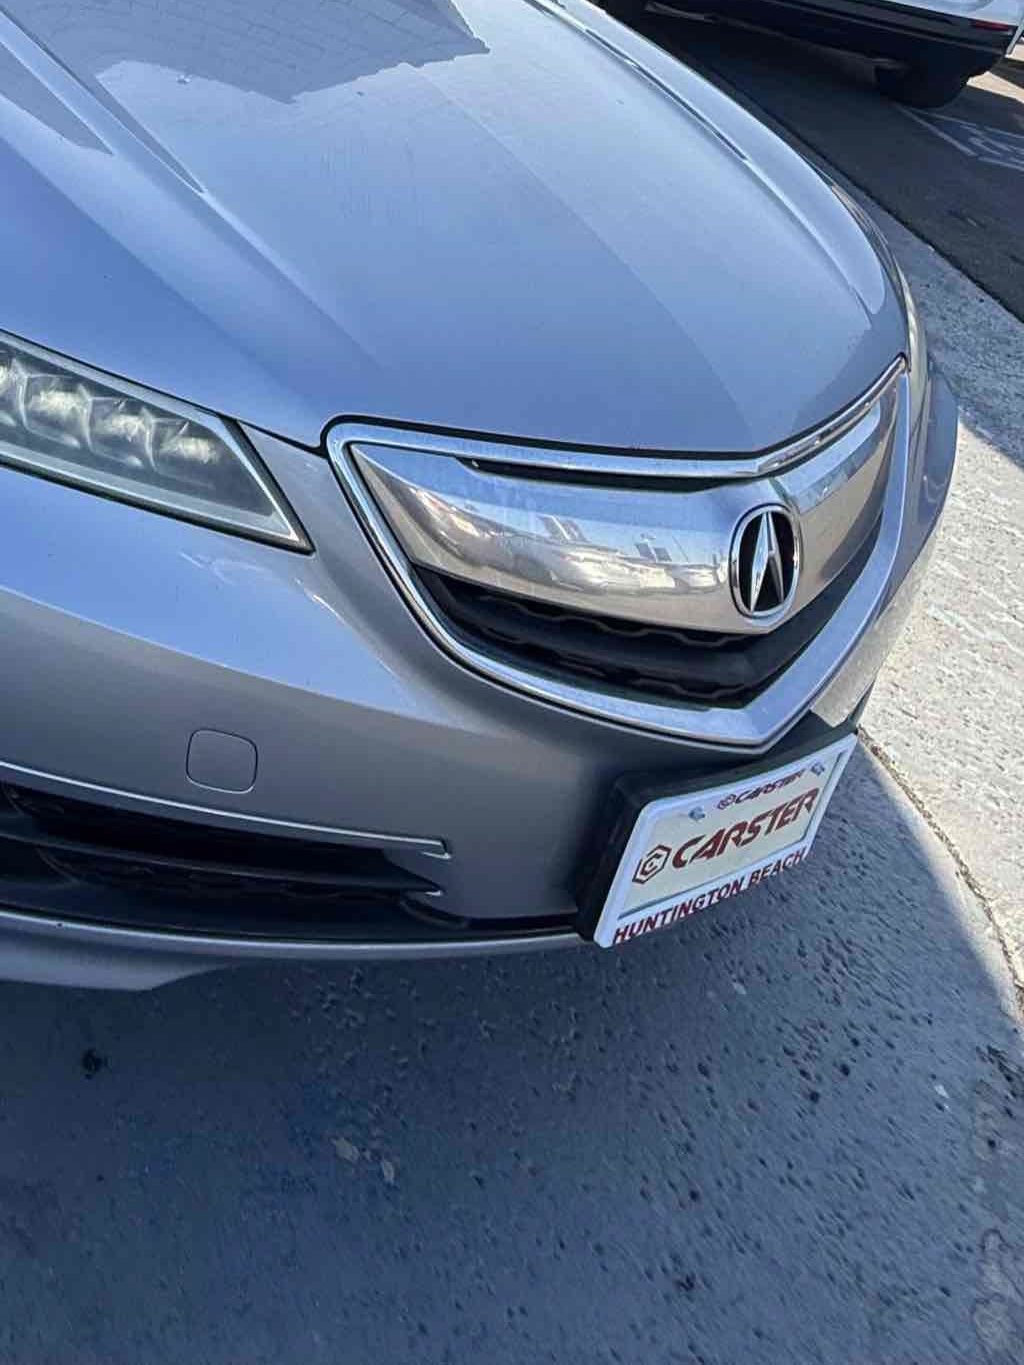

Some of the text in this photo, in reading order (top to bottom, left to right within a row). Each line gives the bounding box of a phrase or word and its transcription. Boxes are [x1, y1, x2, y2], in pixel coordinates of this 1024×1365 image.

[672, 787, 820, 869] CARSTER
[613, 846, 808, 943] HUNTINGTON BEACH
